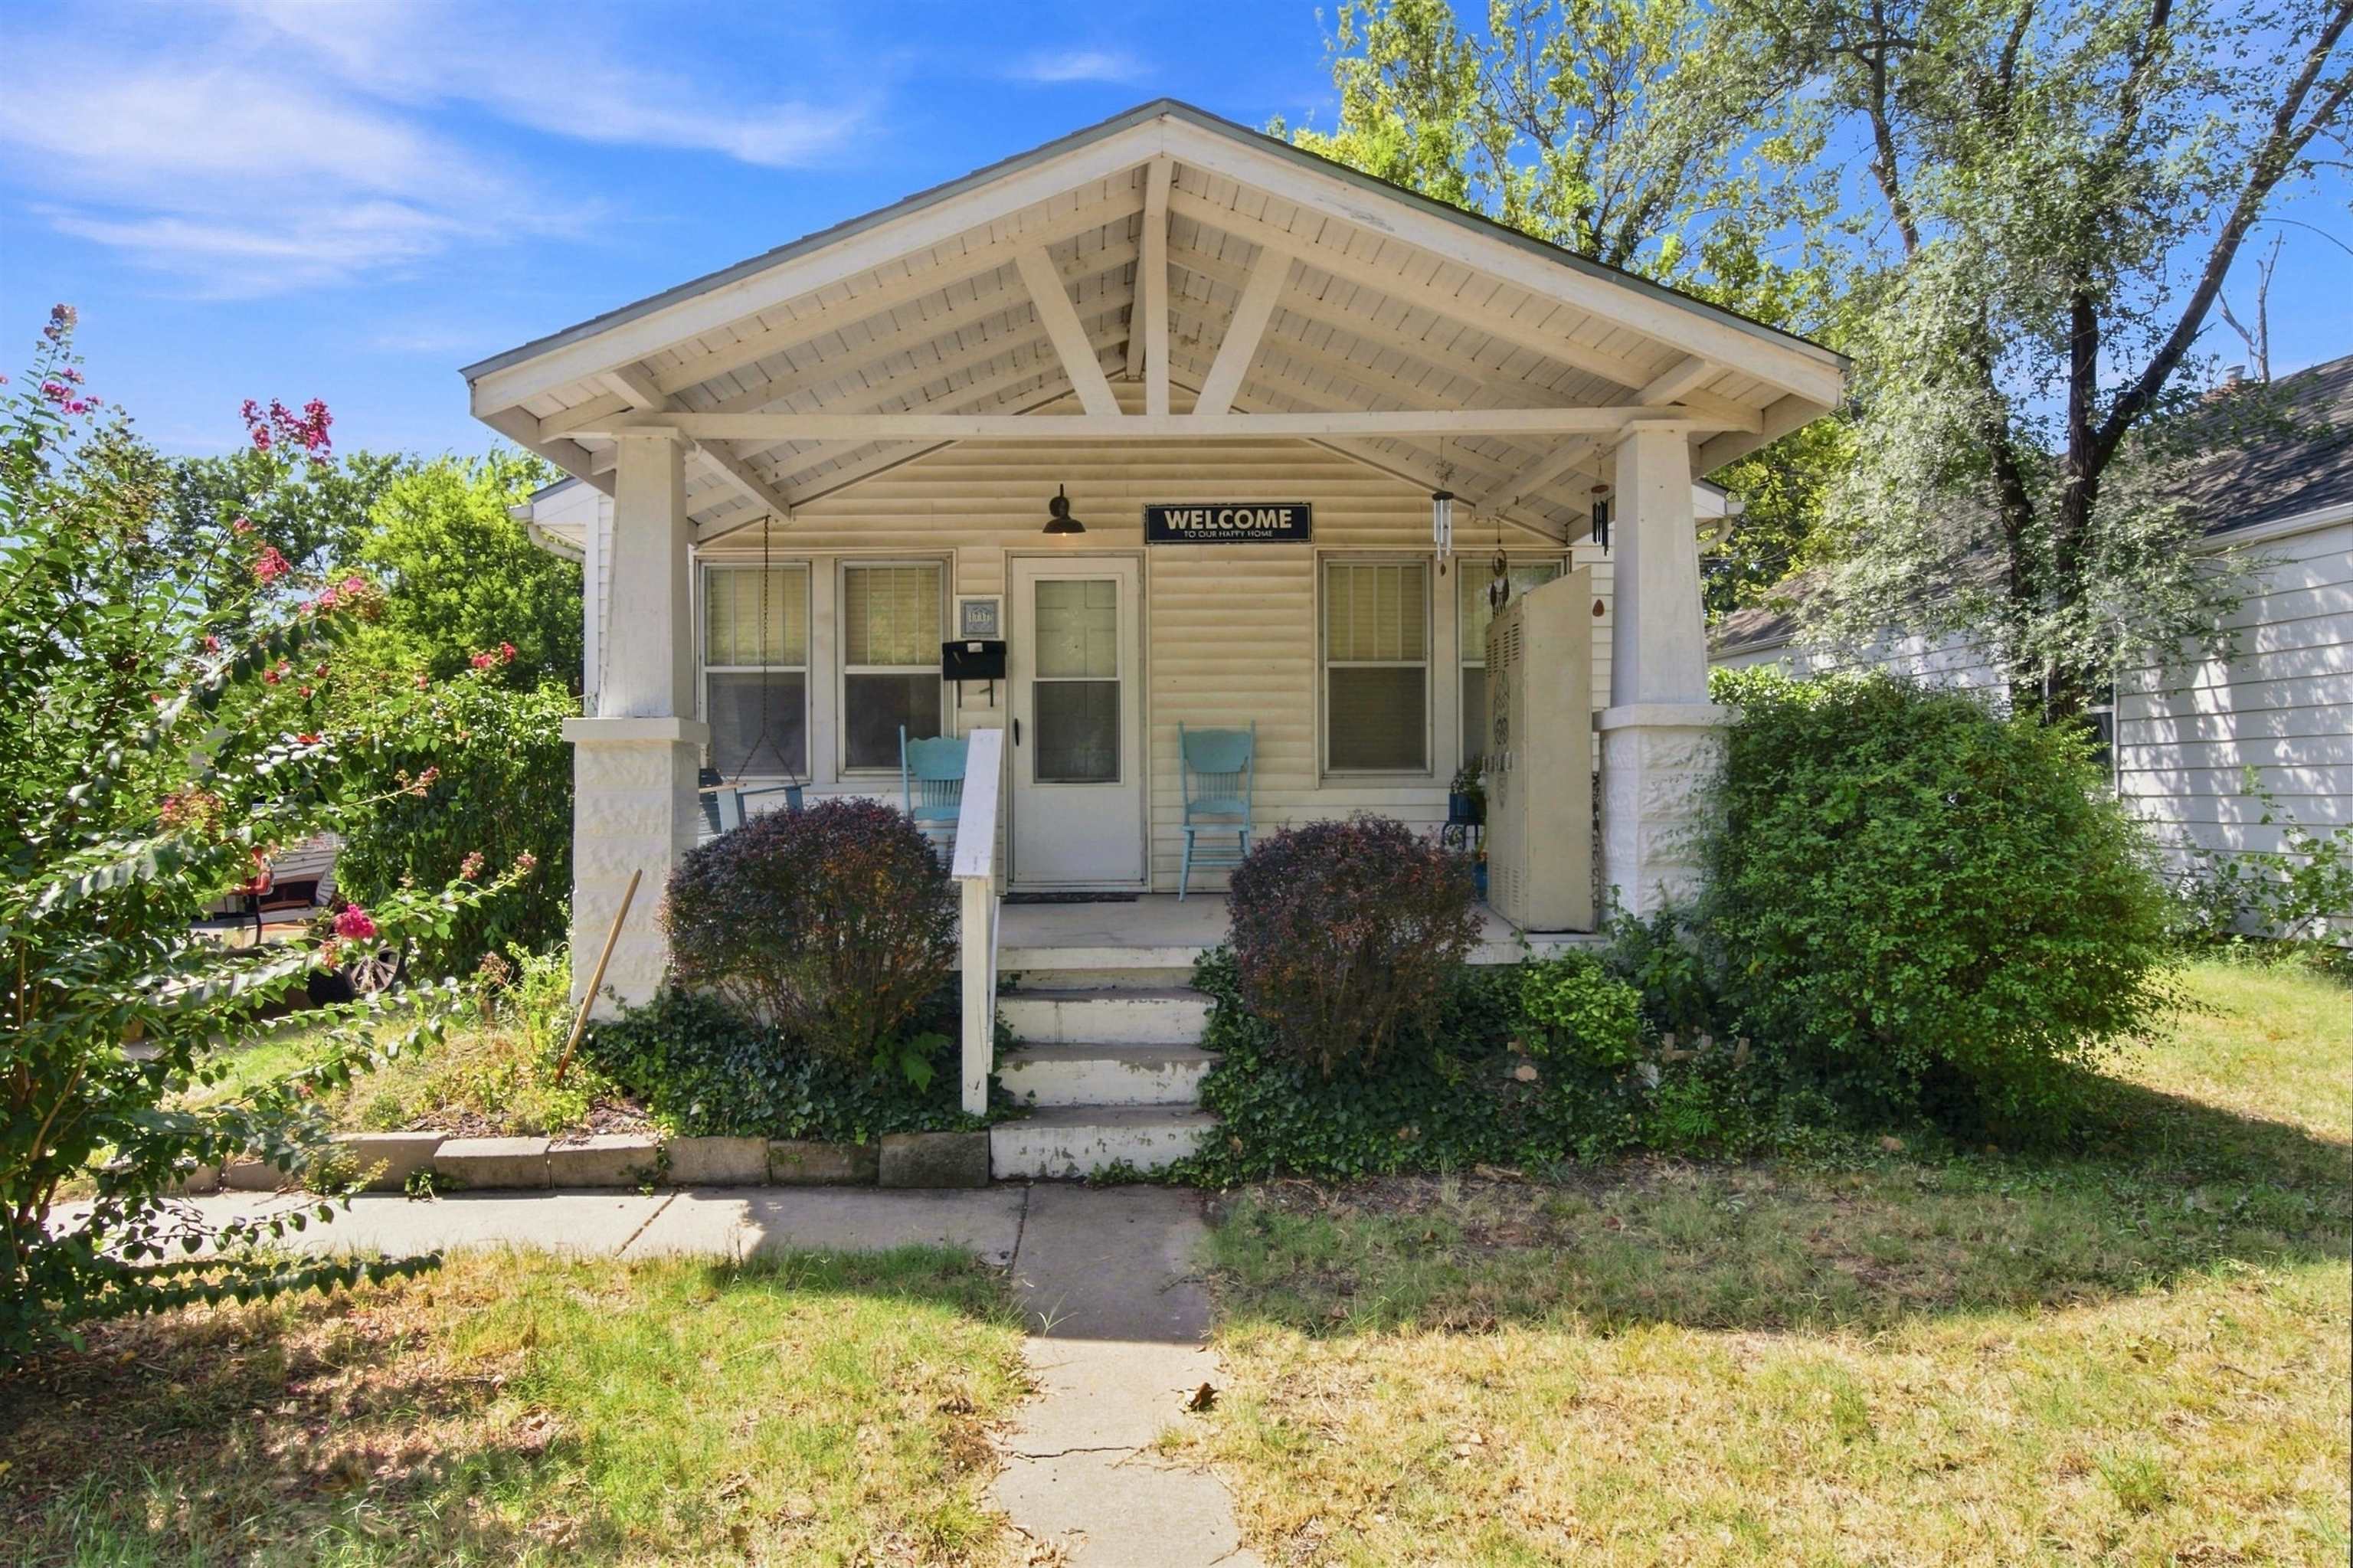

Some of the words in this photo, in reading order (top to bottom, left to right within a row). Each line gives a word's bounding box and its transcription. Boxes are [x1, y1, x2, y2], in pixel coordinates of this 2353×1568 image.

[1163, 509, 1293, 530] WELCOME
[1184, 530, 1196, 538] TO
[1197, 530, 1217, 538] OUR
